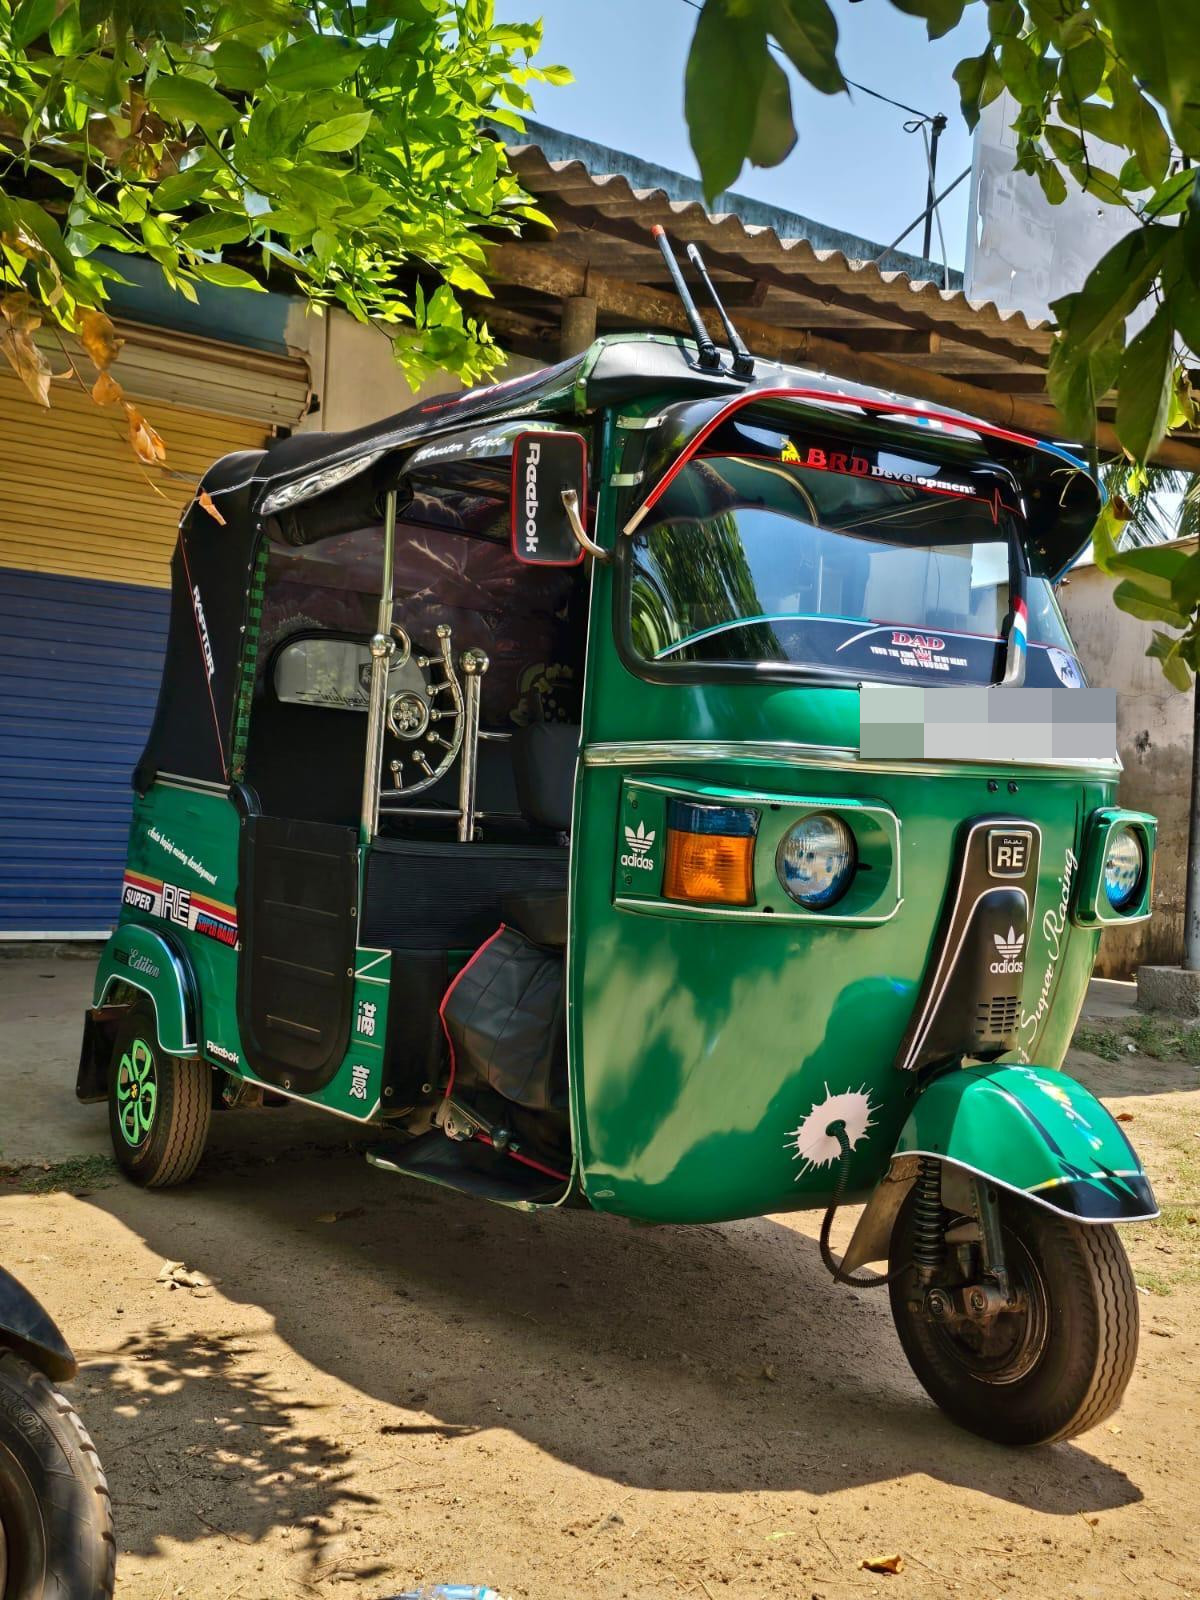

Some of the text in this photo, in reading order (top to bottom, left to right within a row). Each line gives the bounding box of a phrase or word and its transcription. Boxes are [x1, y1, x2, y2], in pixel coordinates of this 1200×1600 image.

[466, 435, 507, 452] Force
[807, 448, 977, 495] BRD Development
[525, 442, 541, 553] Reebok
[194, 585, 215, 684] RAPTOR
[891, 631, 946, 651] DAD
[620, 853, 654, 871] adidas
[997, 846, 1025, 867] RE
[187, 855, 218, 886] development
[125, 889, 152, 911] SUPER
[161, 882, 192, 928] RE
[1042, 848, 1079, 961] Racing
[196, 913, 218, 939] SUPER
[128, 946, 160, 978] Edition
[990, 959, 1024, 974] adidas
[206, 1039, 240, 1064] Reebok
